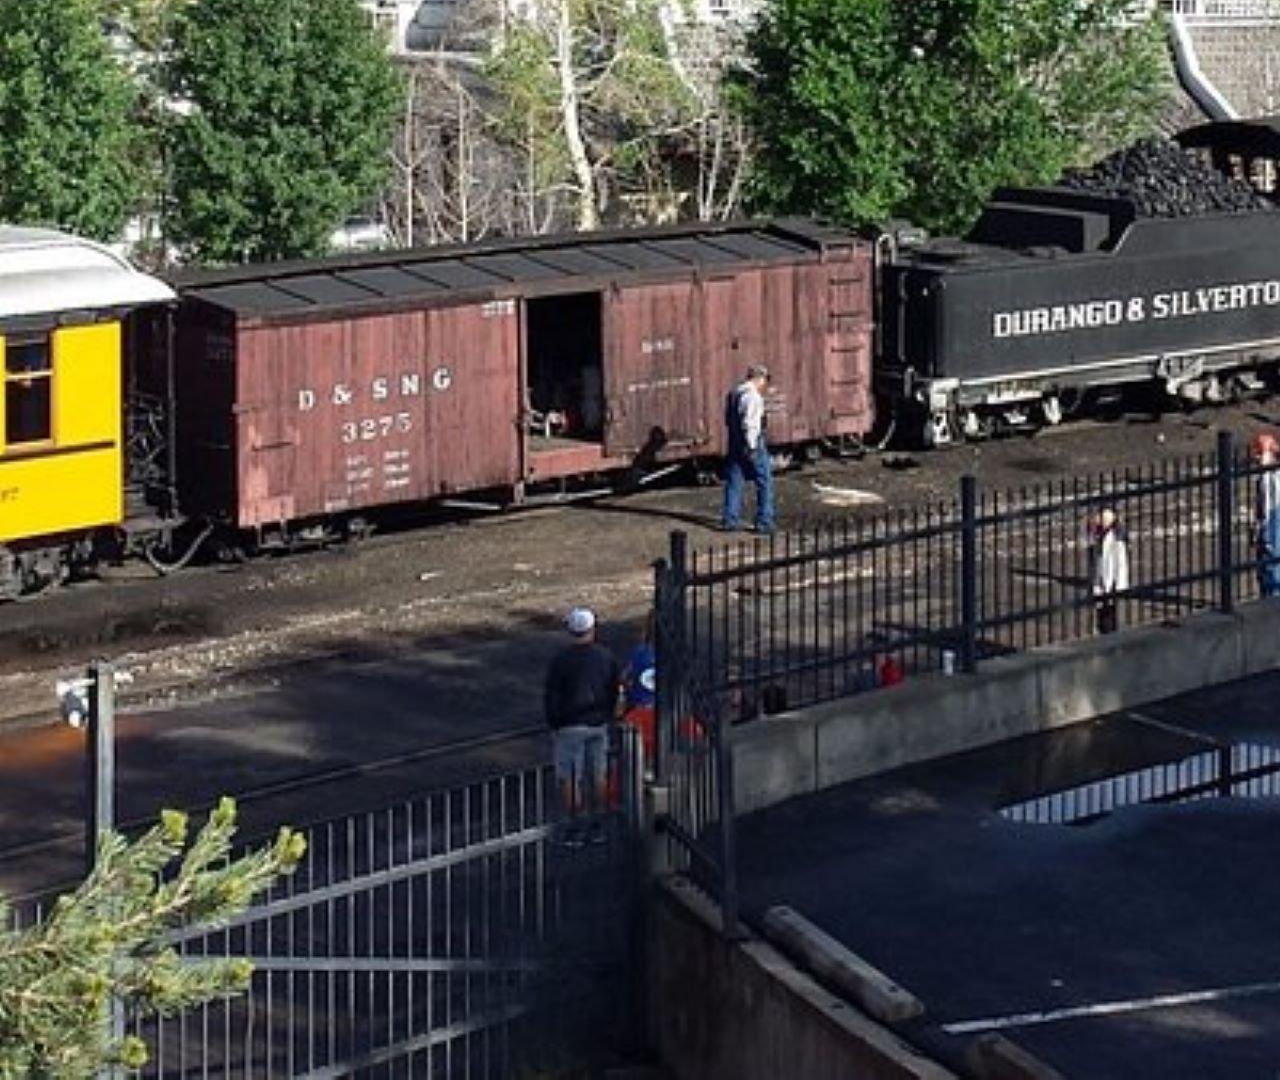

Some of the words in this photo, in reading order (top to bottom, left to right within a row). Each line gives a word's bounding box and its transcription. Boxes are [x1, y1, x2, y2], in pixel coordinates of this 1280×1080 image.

[993, 299, 1121, 338] DURANGO
[1127, 297, 1146, 322] &
[340, 412, 413, 443] 3275
